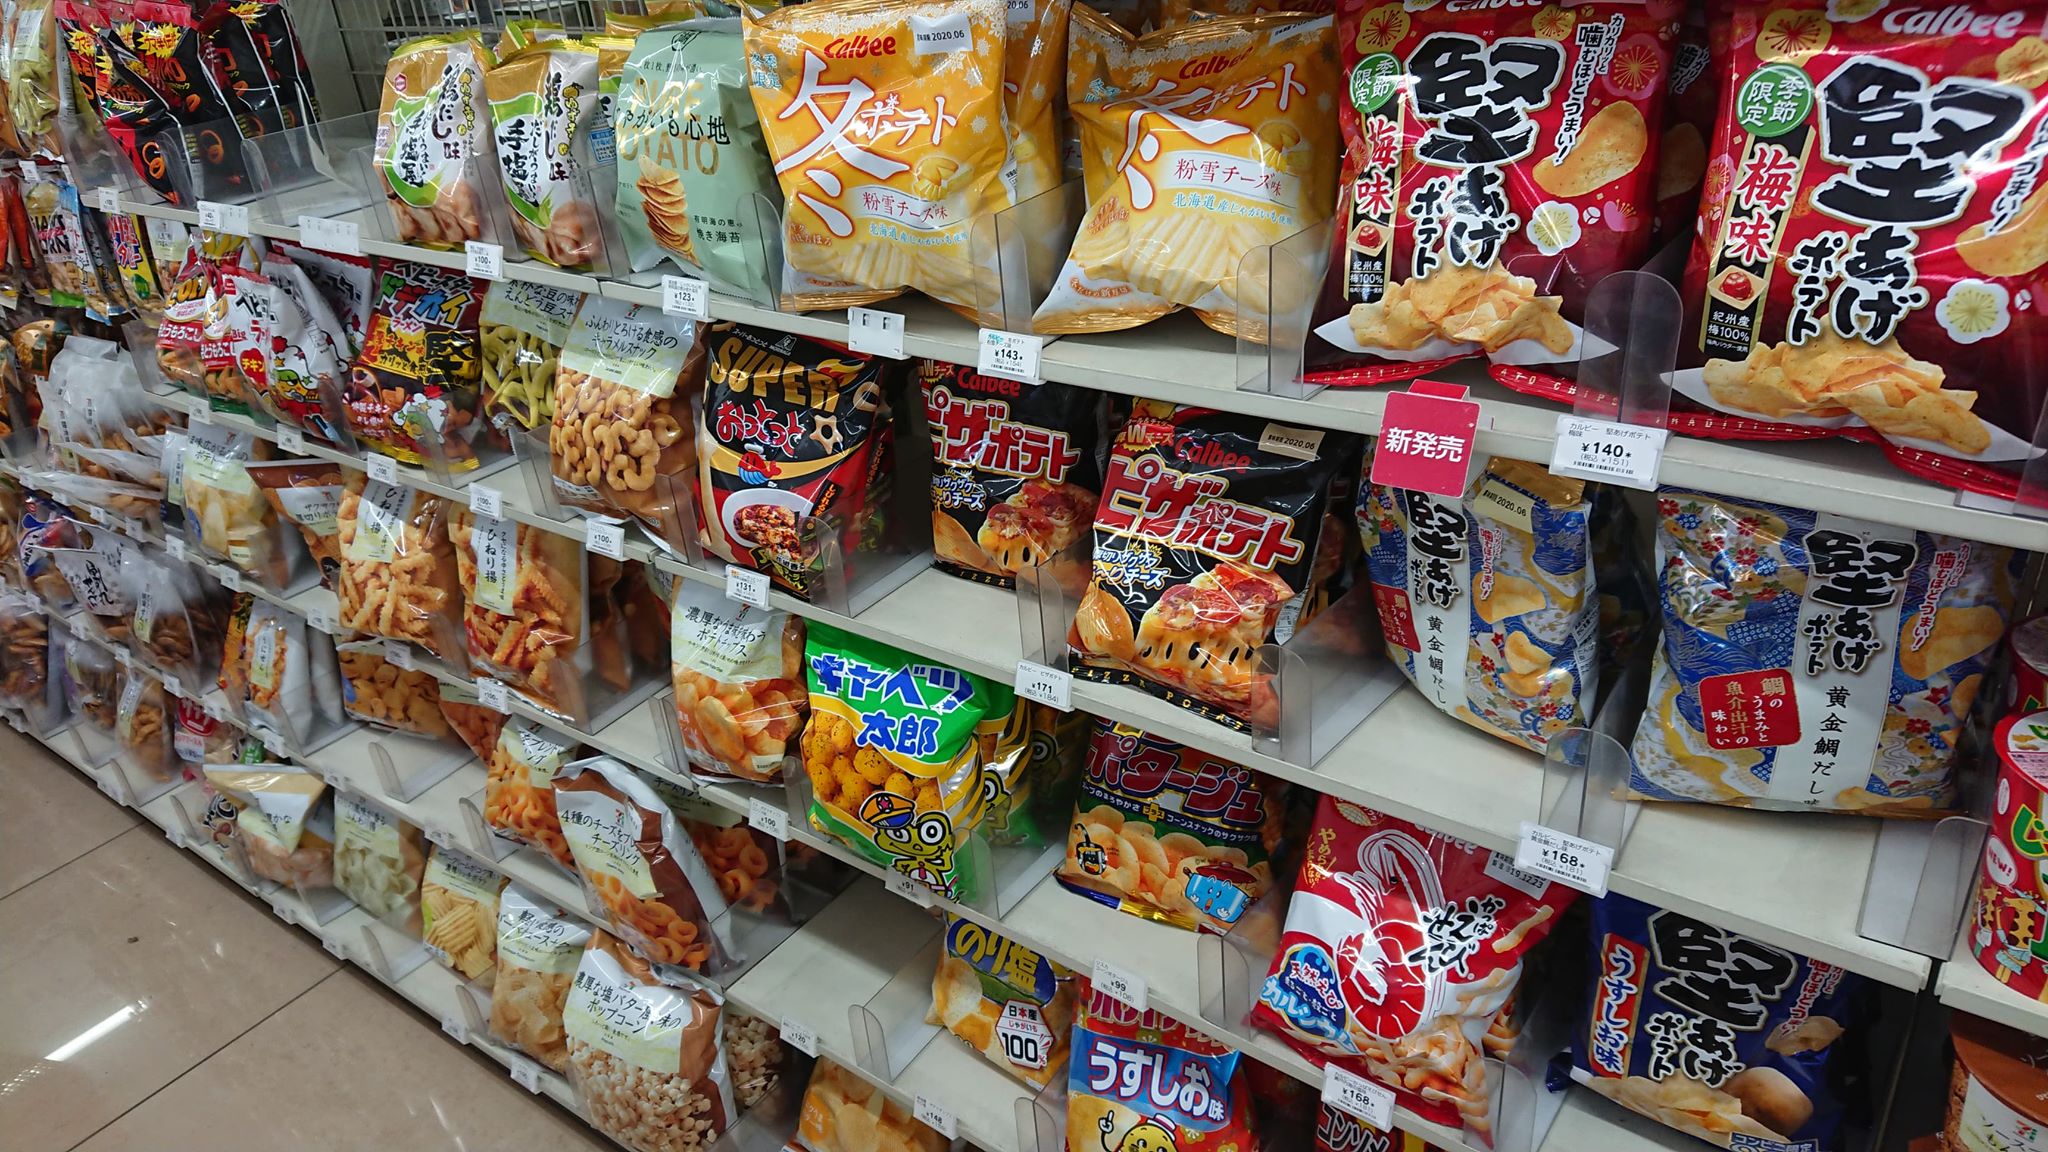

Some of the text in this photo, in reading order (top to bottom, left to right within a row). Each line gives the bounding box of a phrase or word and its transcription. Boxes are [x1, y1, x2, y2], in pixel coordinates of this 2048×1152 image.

[931, 30, 965, 41] 2020.06
[1882, 6, 2027, 39] Calbee
[751, 54, 778, 69] 冬季
[824, 35, 897, 59] Calbee
[1179, 47, 1254, 80] Calbee
[1741, 82, 1773, 127] 限定
[1768, 74, 1807, 125] 季節
[1174, 157, 1283, 197] 粉雪チーズ味
[1356, 117, 1400, 219] 梅味
[863, 192, 948, 222] 粉雪チーズ味
[1728, 147, 1801, 265] 梅味
[1410, 181, 1448, 280] ポテト
[1350, 272, 1384, 286] 梅100%
[1353, 260, 1383, 272] 紀州産
[674, 291, 692, 302] ¥123
[1790, 236, 1848, 345] ポテト
[1707, 323, 1750, 342] 梅100%
[1711, 310, 1752, 328] 紀州産
[994, 348, 1019, 361] ¥143
[711, 336, 840, 413] SUPER
[716, 398, 806, 459] おっとっと
[1282, 437, 1316, 450] 2020.06
[1569, 423, 1652, 441] カルビー 堅あげポテト
[1175, 437, 1252, 474] Calbee
[1386, 427, 1466, 464] 新発売
[1581, 442, 1625, 458] ¥140
[1094, 457, 1306, 571] ピザポテト
[1495, 494, 1528, 518] 2020.06
[484, 527, 498, 584] ひねり揚
[1803, 613, 1833, 675] ポテト
[811, 652, 976, 716] キャベツ
[1031, 681, 1053, 694] ¥171
[857, 711, 941, 758] 太郎
[1711, 709, 1731, 746] 味わい
[1542, 848, 1579, 868] ¥168
[1987, 845, 2014, 878] NEW!
[1110, 980, 1127, 992] ¥99
[1008, 1004, 1038, 1022] 日本産
[1008, 1020, 1038, 1033] じゃがいも
[1595, 945, 1639, 1075] うすしお味
[1650, 1013, 1684, 1081] ポテト
[1090, 1041, 1226, 1122] うすしお味
[1342, 1087, 1370, 1106] ¥168
